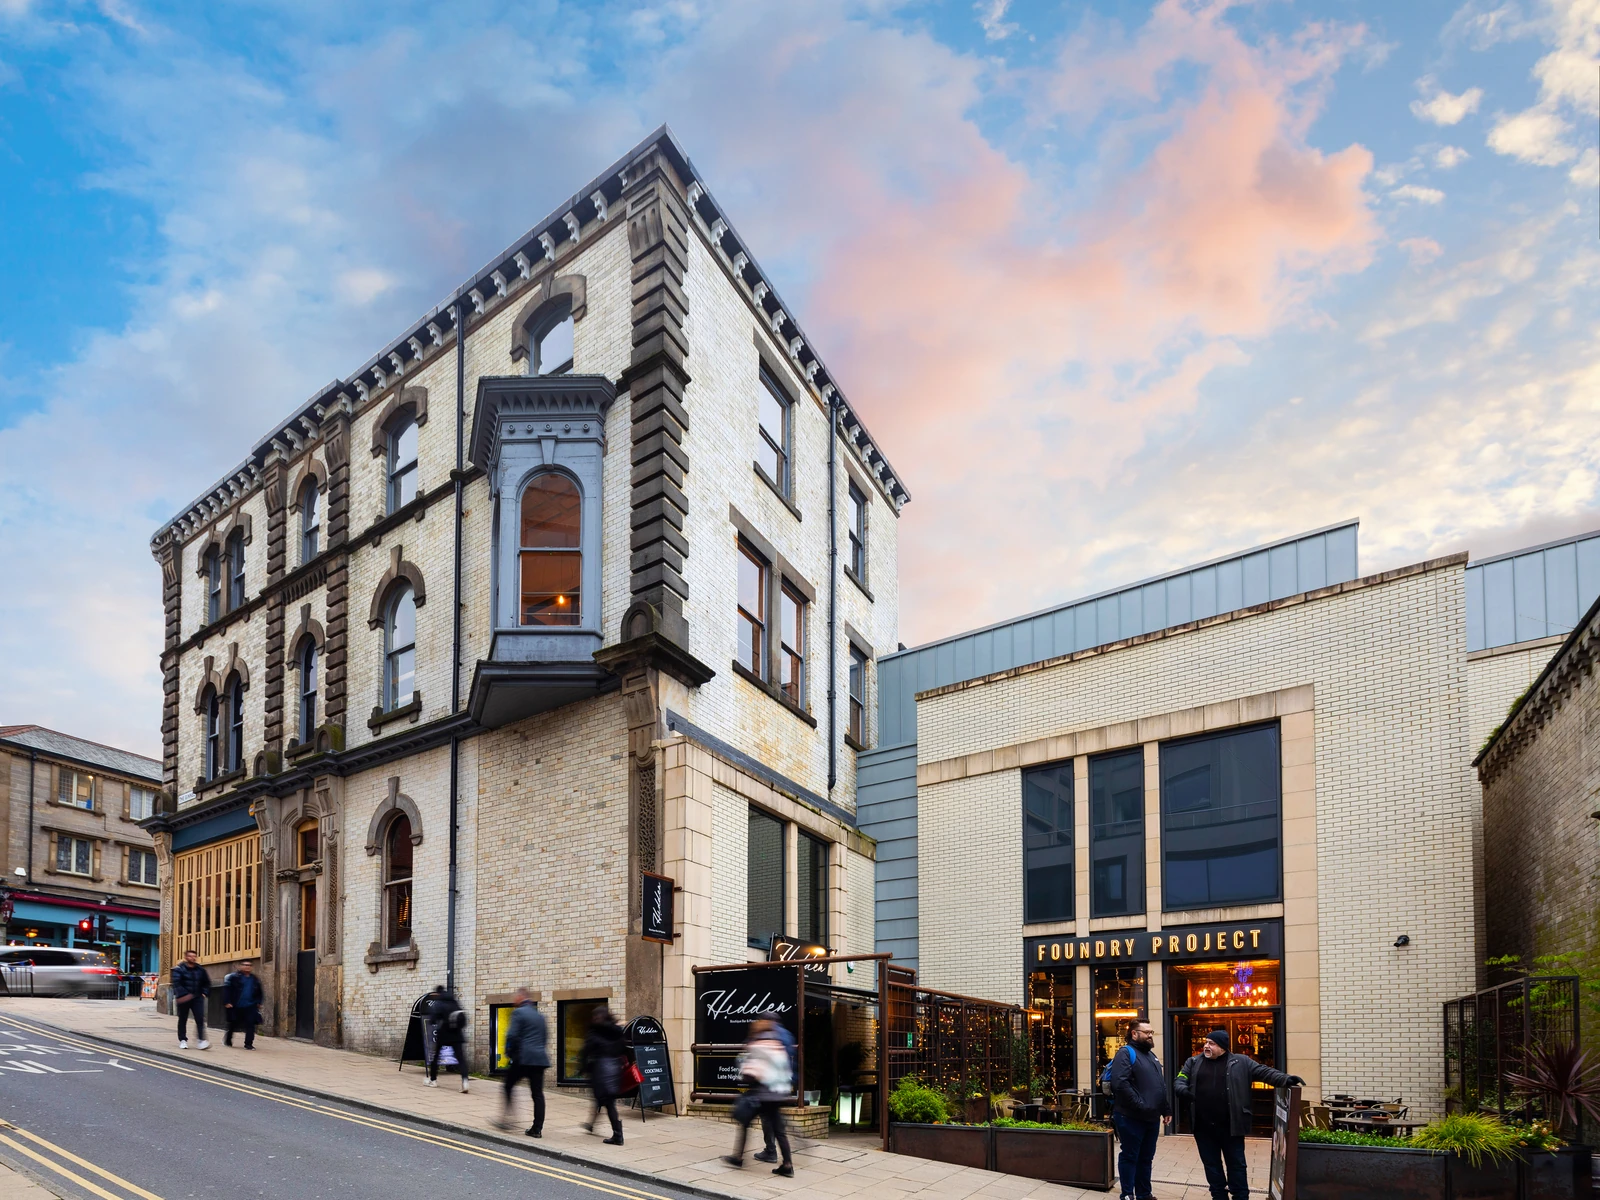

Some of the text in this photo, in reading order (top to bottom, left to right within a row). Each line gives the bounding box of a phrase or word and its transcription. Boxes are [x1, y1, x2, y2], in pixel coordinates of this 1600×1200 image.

[653, 881, 662, 928] Hidden
[1038, 929, 1261, 961] FOUNDRY PROJECT
[699, 988, 792, 1020] Hidden
[636, 1026, 658, 1034] Hidden
